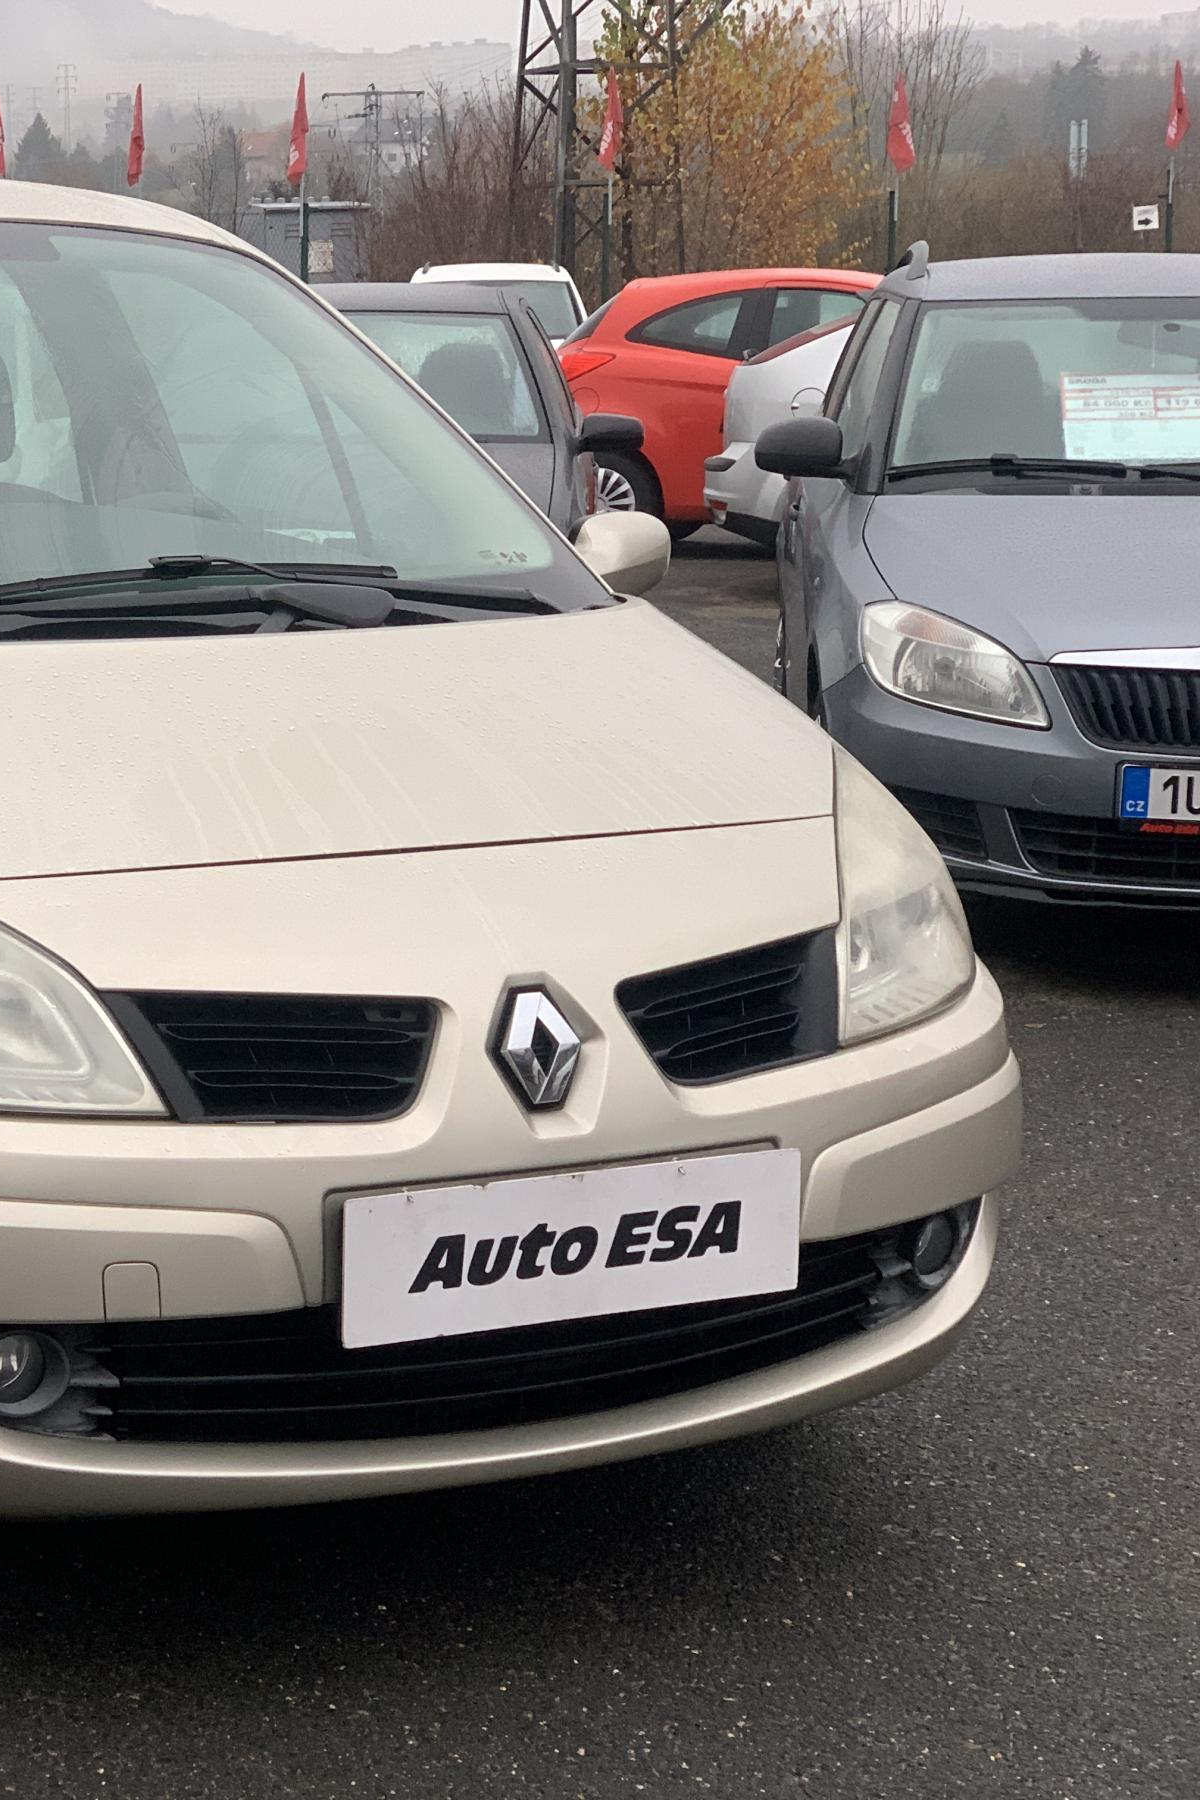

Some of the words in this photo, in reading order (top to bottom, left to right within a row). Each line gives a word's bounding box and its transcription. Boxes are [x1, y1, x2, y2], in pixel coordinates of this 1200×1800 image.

[1125, 800, 1145, 812] CZ
[408, 1223, 599, 1293] Auto
[604, 1200, 742, 1268] ESA
